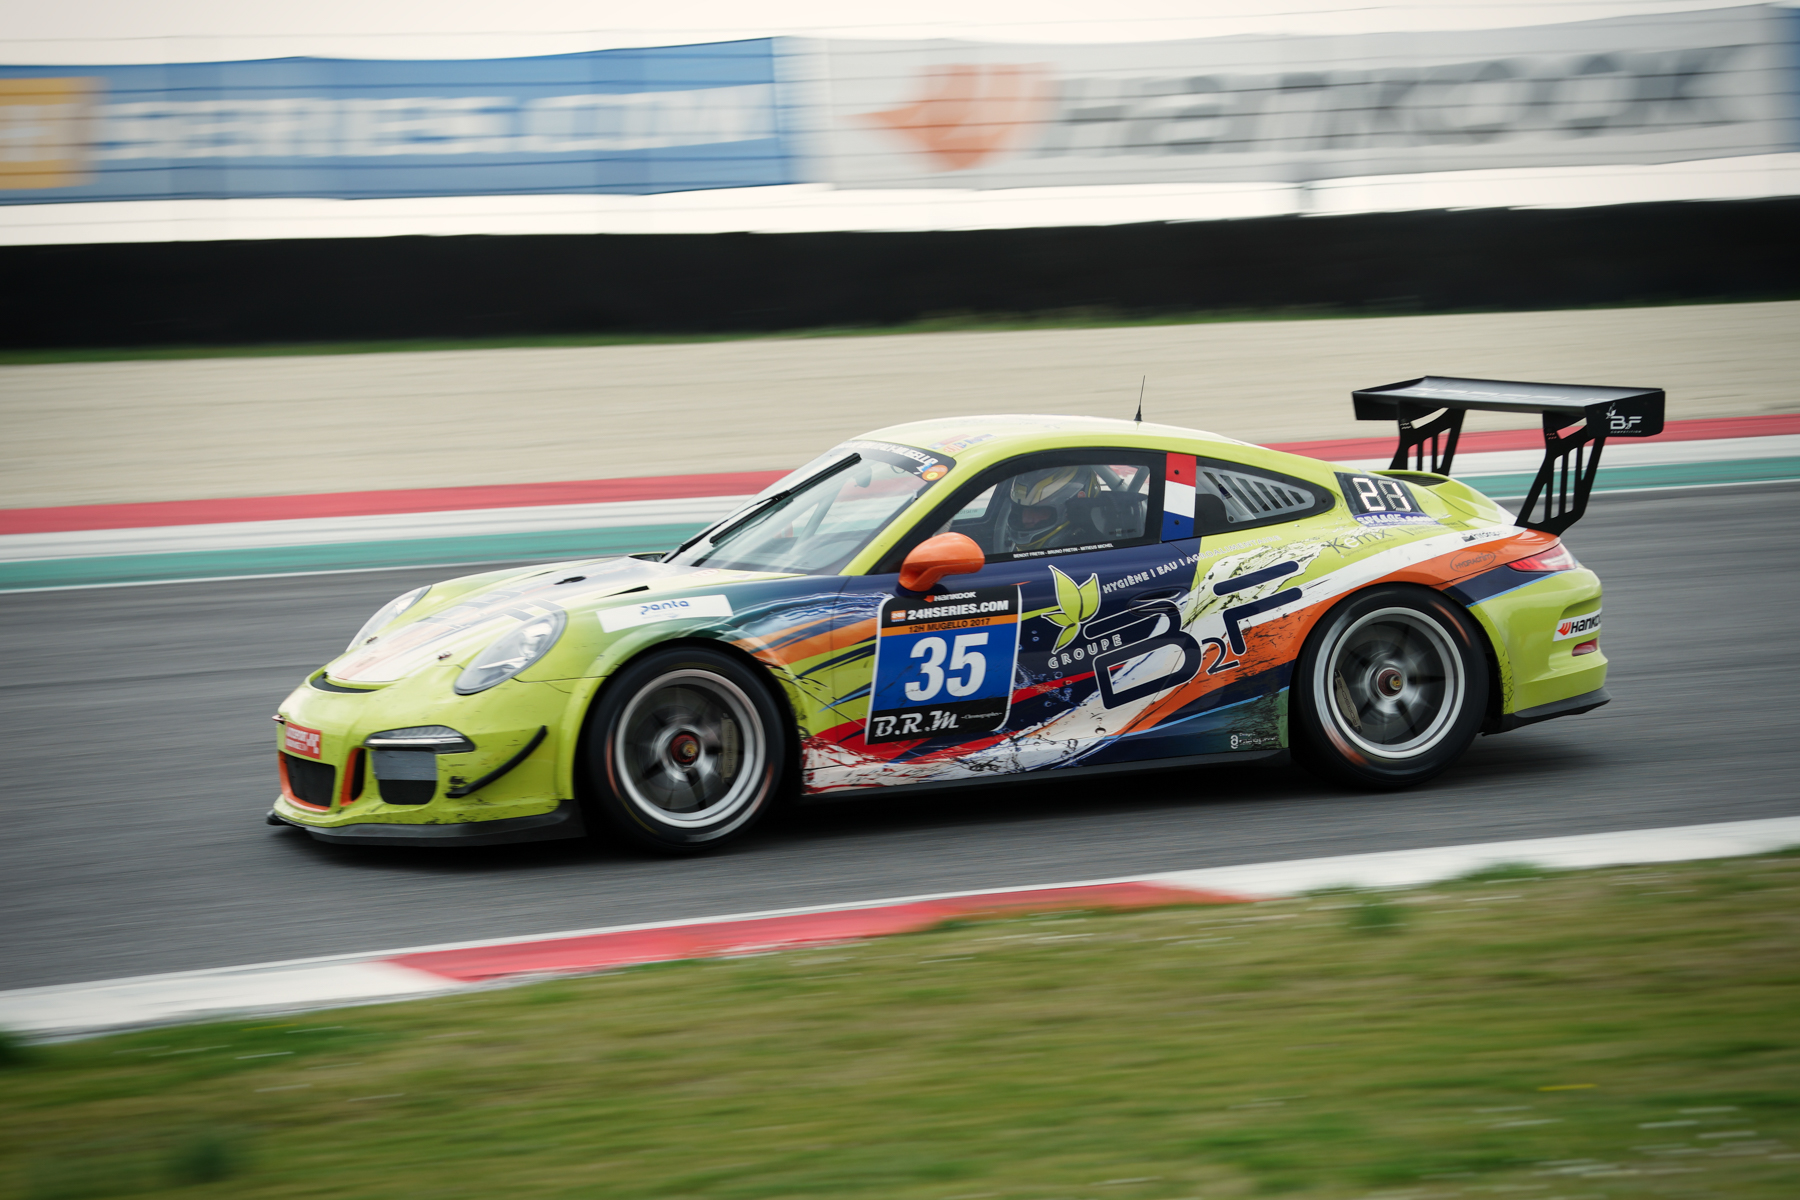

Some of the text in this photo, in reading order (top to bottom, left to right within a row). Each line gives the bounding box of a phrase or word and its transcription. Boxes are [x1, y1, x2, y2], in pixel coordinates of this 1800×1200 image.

[1102, 535, 1283, 594] HYGIÈNE EAU AGROALIMENTAIRE
[907, 600, 1009, 620] 24HSERIES.COM
[909, 618, 991, 633] 12H MUGELLO 2017
[905, 632, 989, 702] 35
[1048, 634, 1123, 668] GROUPE
